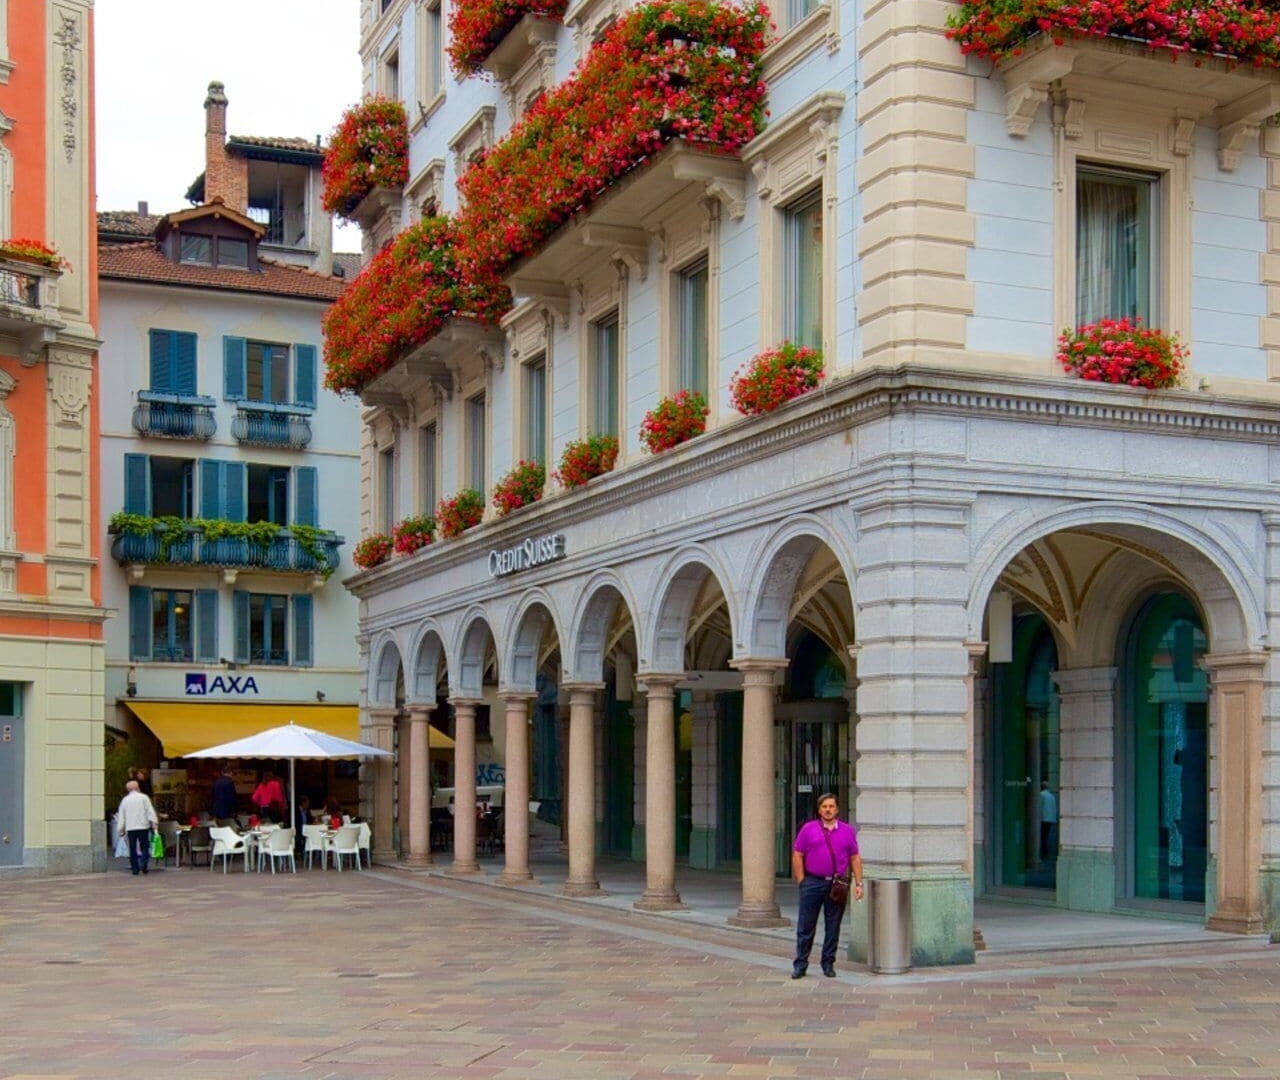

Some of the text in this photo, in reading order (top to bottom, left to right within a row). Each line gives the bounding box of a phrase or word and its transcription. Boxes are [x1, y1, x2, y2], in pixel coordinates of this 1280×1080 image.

[488, 534, 563, 577] CREDIT SUISSE
[209, 675, 259, 694] AXA
